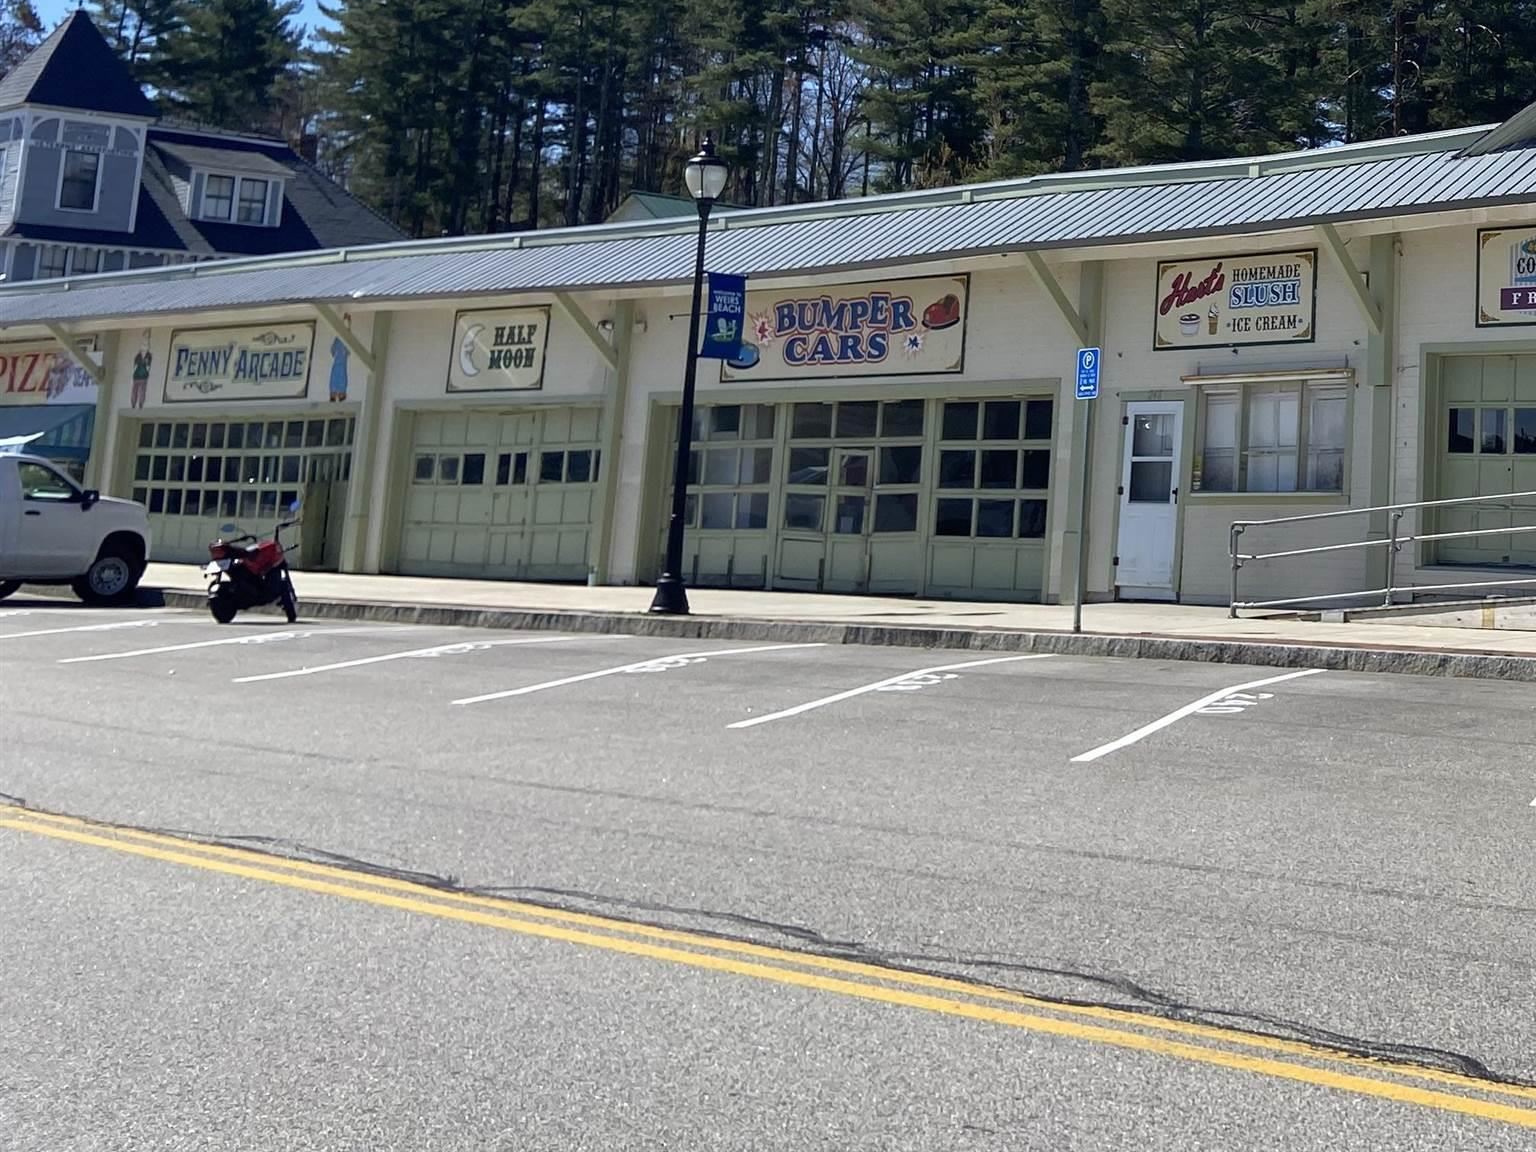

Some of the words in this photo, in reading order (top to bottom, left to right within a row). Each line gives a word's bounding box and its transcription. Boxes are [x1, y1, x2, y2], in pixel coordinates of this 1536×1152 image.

[1232, 264, 1300, 282] HOMEMADE
[1160, 262, 1225, 316] Hart's
[1230, 281, 1300, 308] SLUSH
[775, 293, 917, 336] BUMPER
[1232, 318, 1250, 332] ICE
[1256, 315, 1298, 330] CREAM
[493, 324, 537, 346] HALF
[783, 332, 889, 365] CARS
[175, 343, 234, 377] PENNY
[234, 349, 306, 382] ARCADE
[488, 348, 536, 369] MOON
